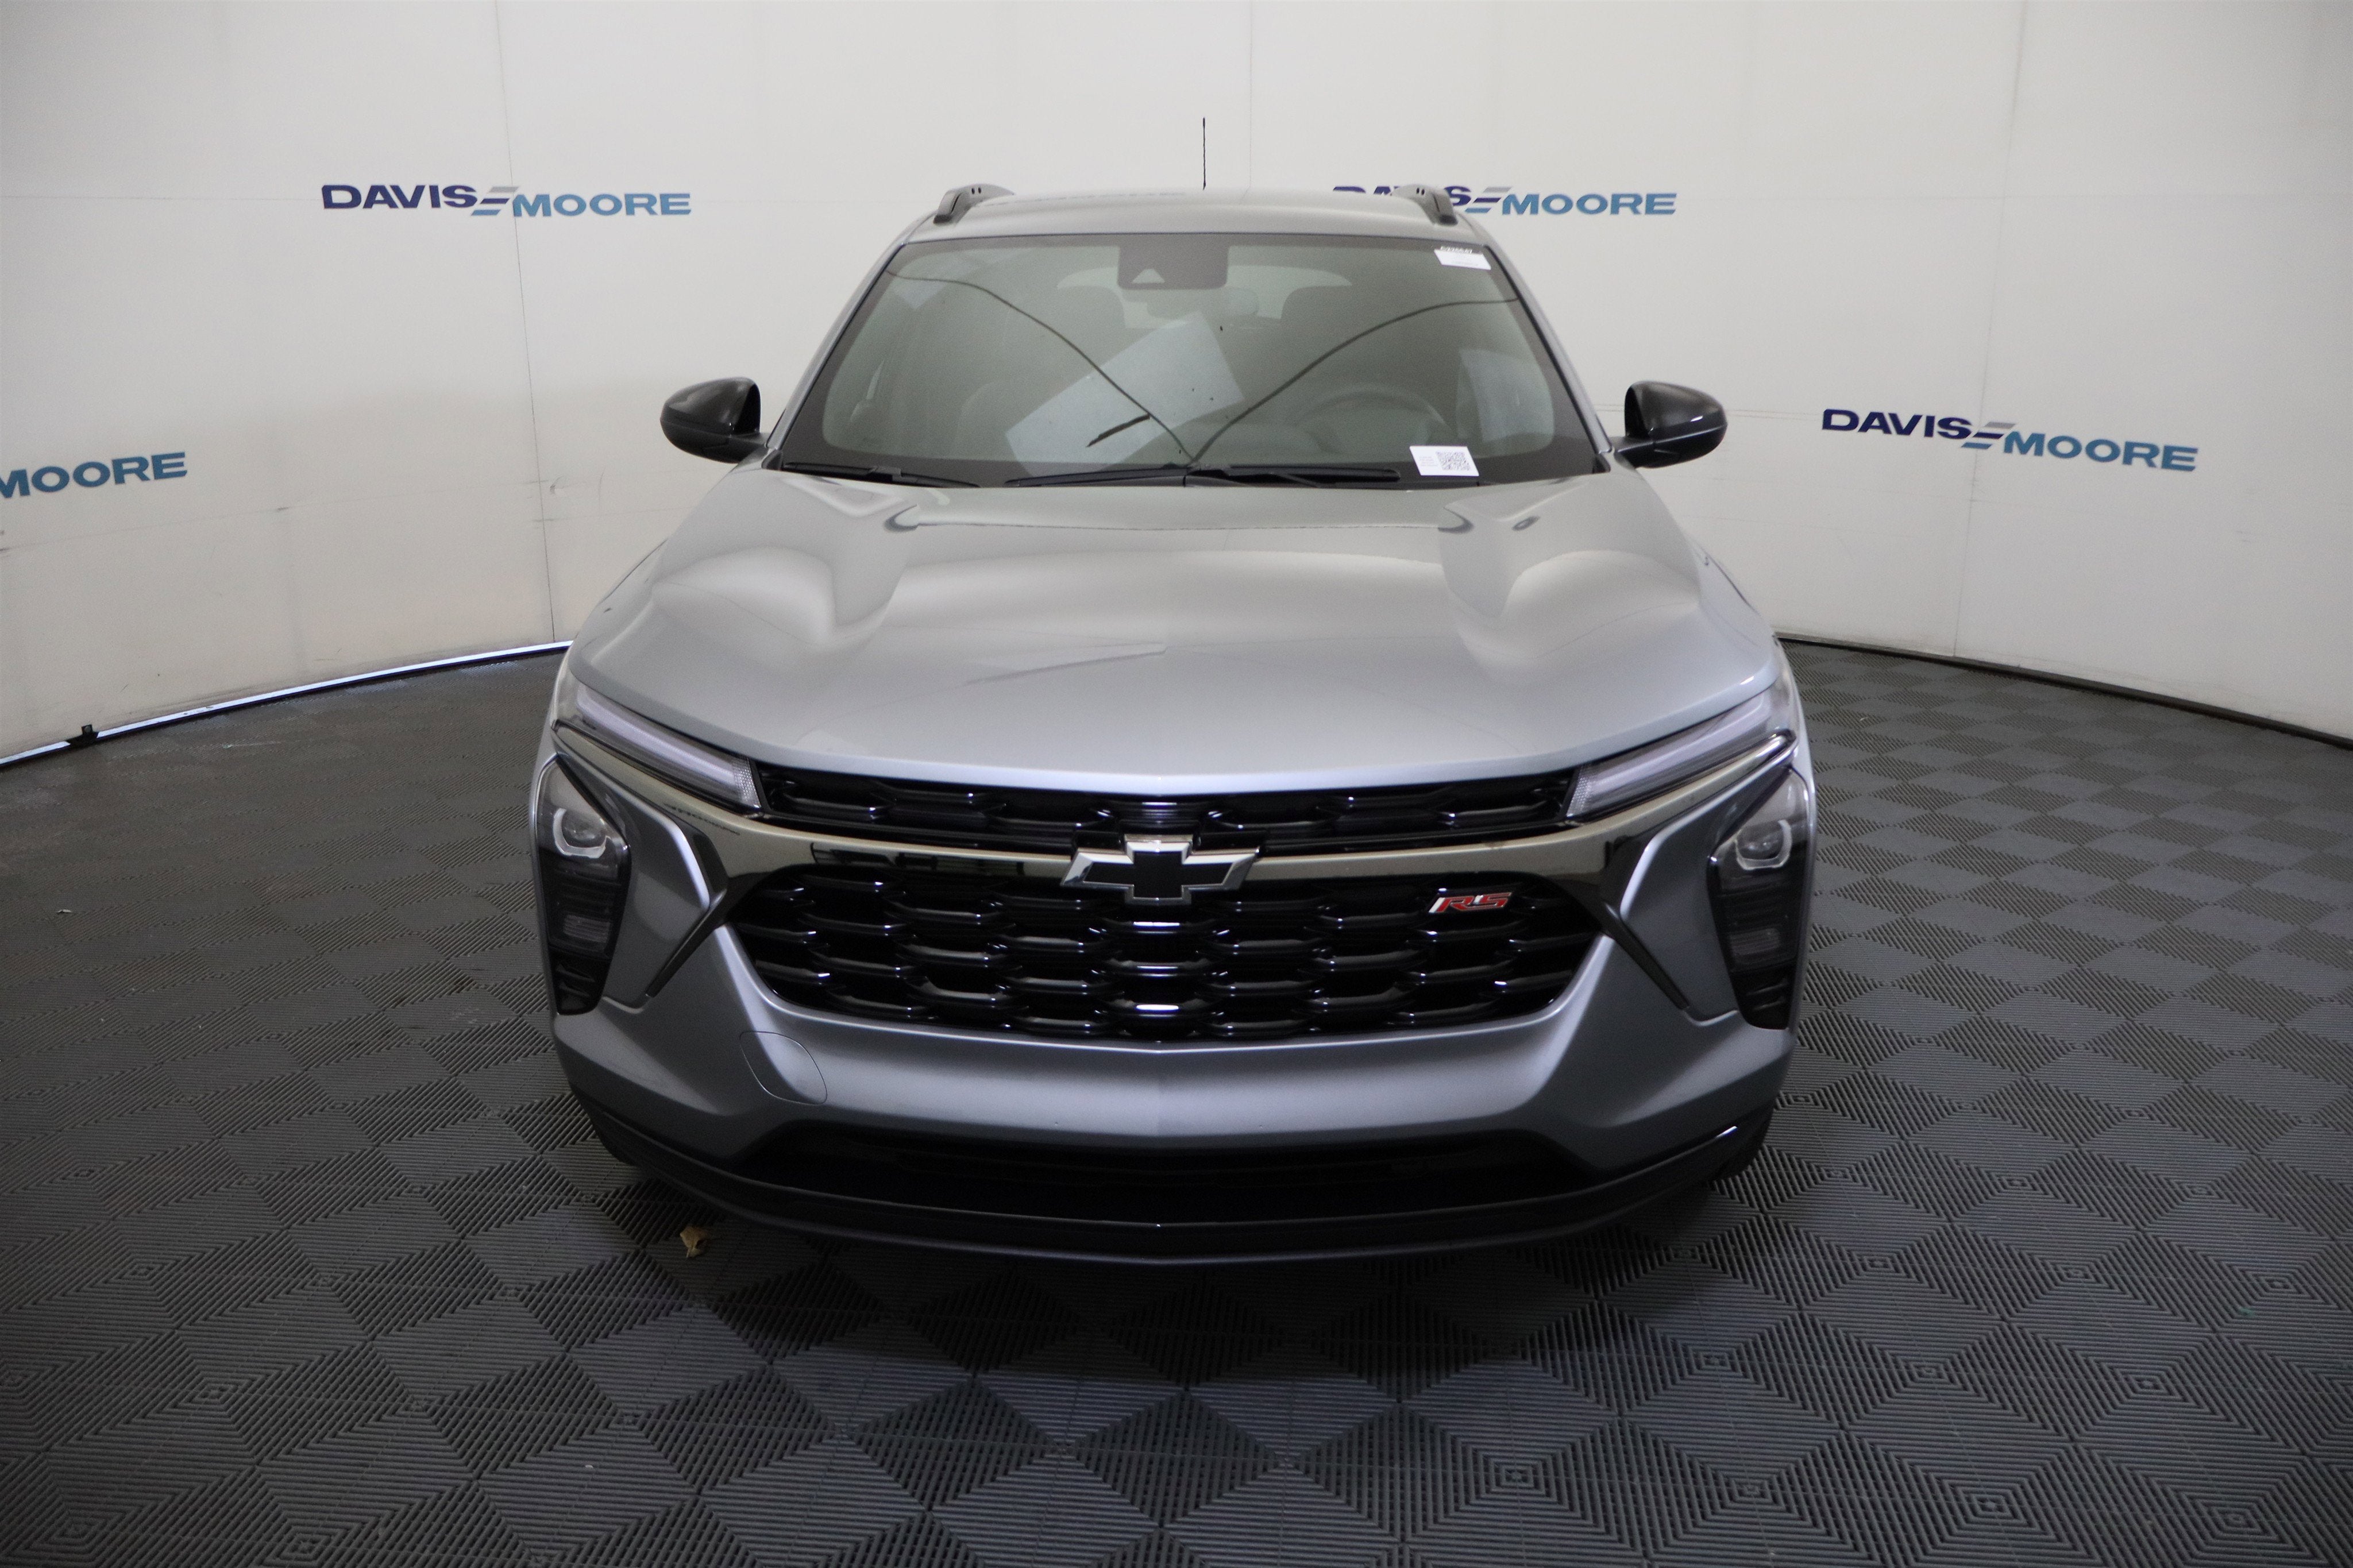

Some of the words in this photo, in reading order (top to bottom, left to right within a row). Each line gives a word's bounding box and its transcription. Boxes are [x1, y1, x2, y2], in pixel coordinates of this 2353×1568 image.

[322, 184, 477, 209] DAVIS
[512, 194, 692, 217] MOORE
[1502, 193, 1677, 215] MOORE
[1822, 409, 1972, 439] DAVIS
[2004, 431, 2198, 472] MOORE
[0, 452, 188, 499] MOORE
[1428, 892, 1512, 913] RS
